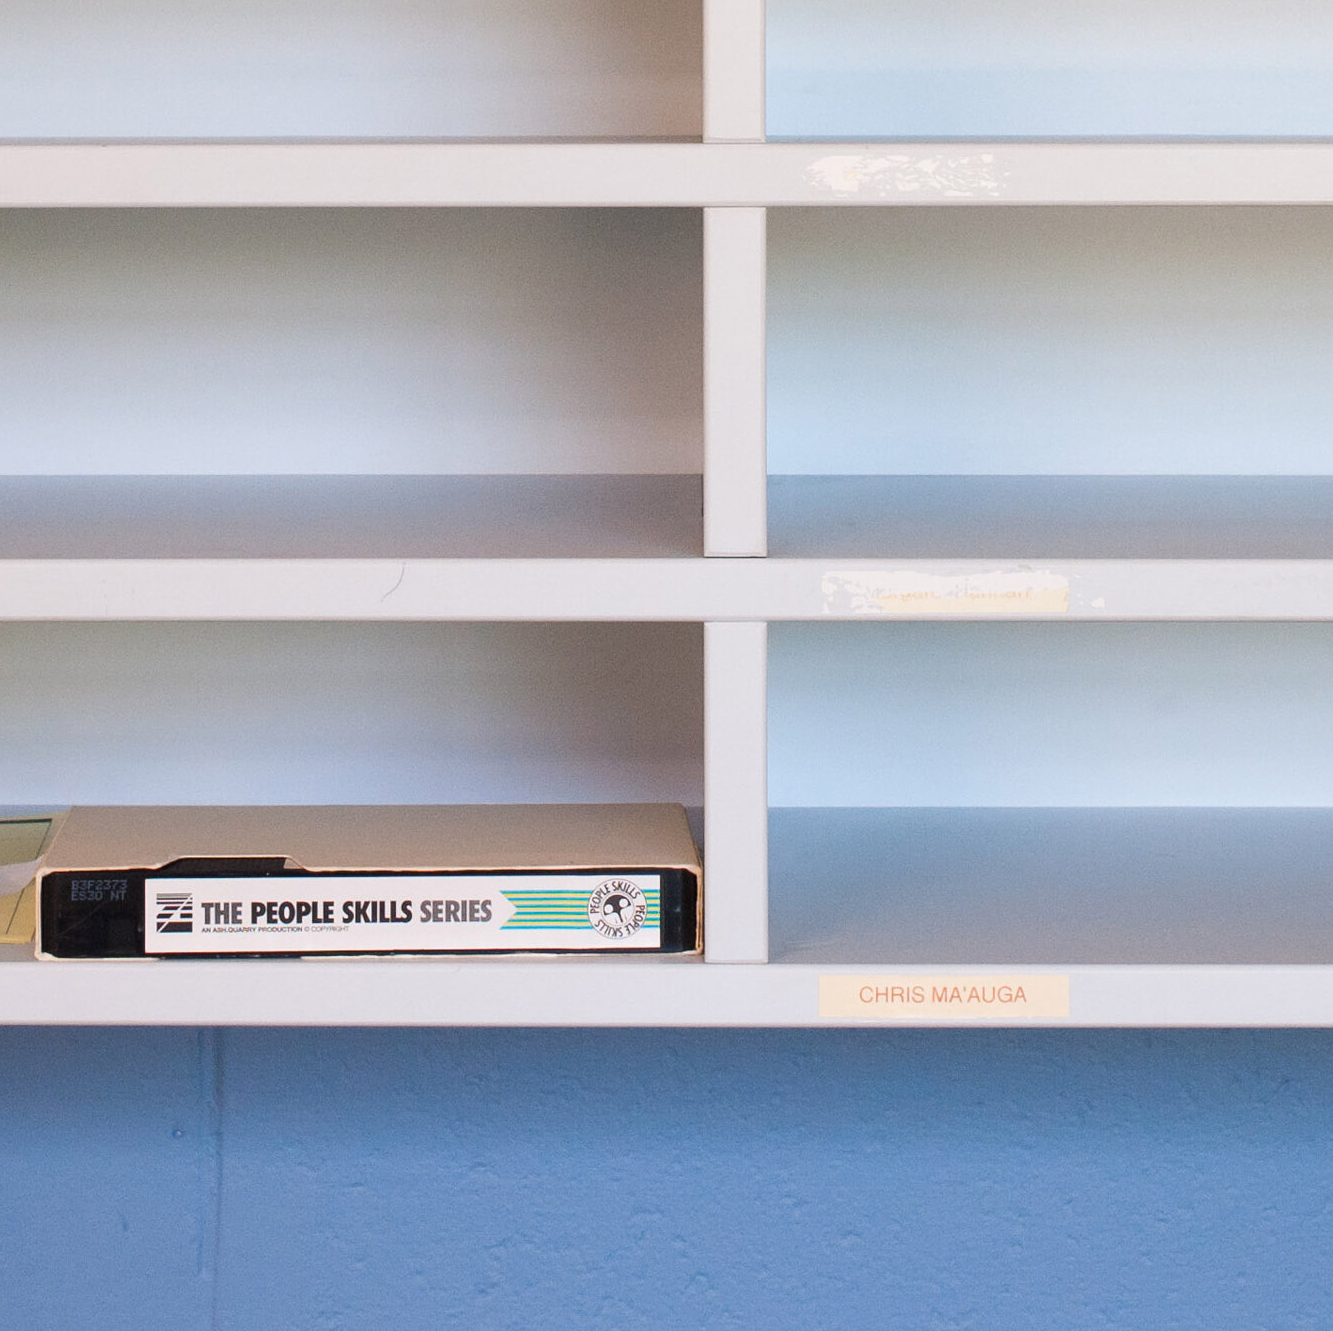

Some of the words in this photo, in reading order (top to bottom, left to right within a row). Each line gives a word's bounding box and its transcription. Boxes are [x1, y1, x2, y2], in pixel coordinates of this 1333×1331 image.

[589, 882, 611, 914] PEOPLE
[611, 880, 642, 900] SKILLS
[201, 901, 243, 924] THE
[251, 900, 334, 924] PEOPLE
[343, 899, 413, 923] SKILLS
[419, 898, 493, 922] SERIES
[624, 904, 646, 935] PEOPLE
[594, 919, 624, 937] SKILLS
[859, 985, 925, 1004] CHRIS
[931, 985, 1027, 1003] MA'AUGA
